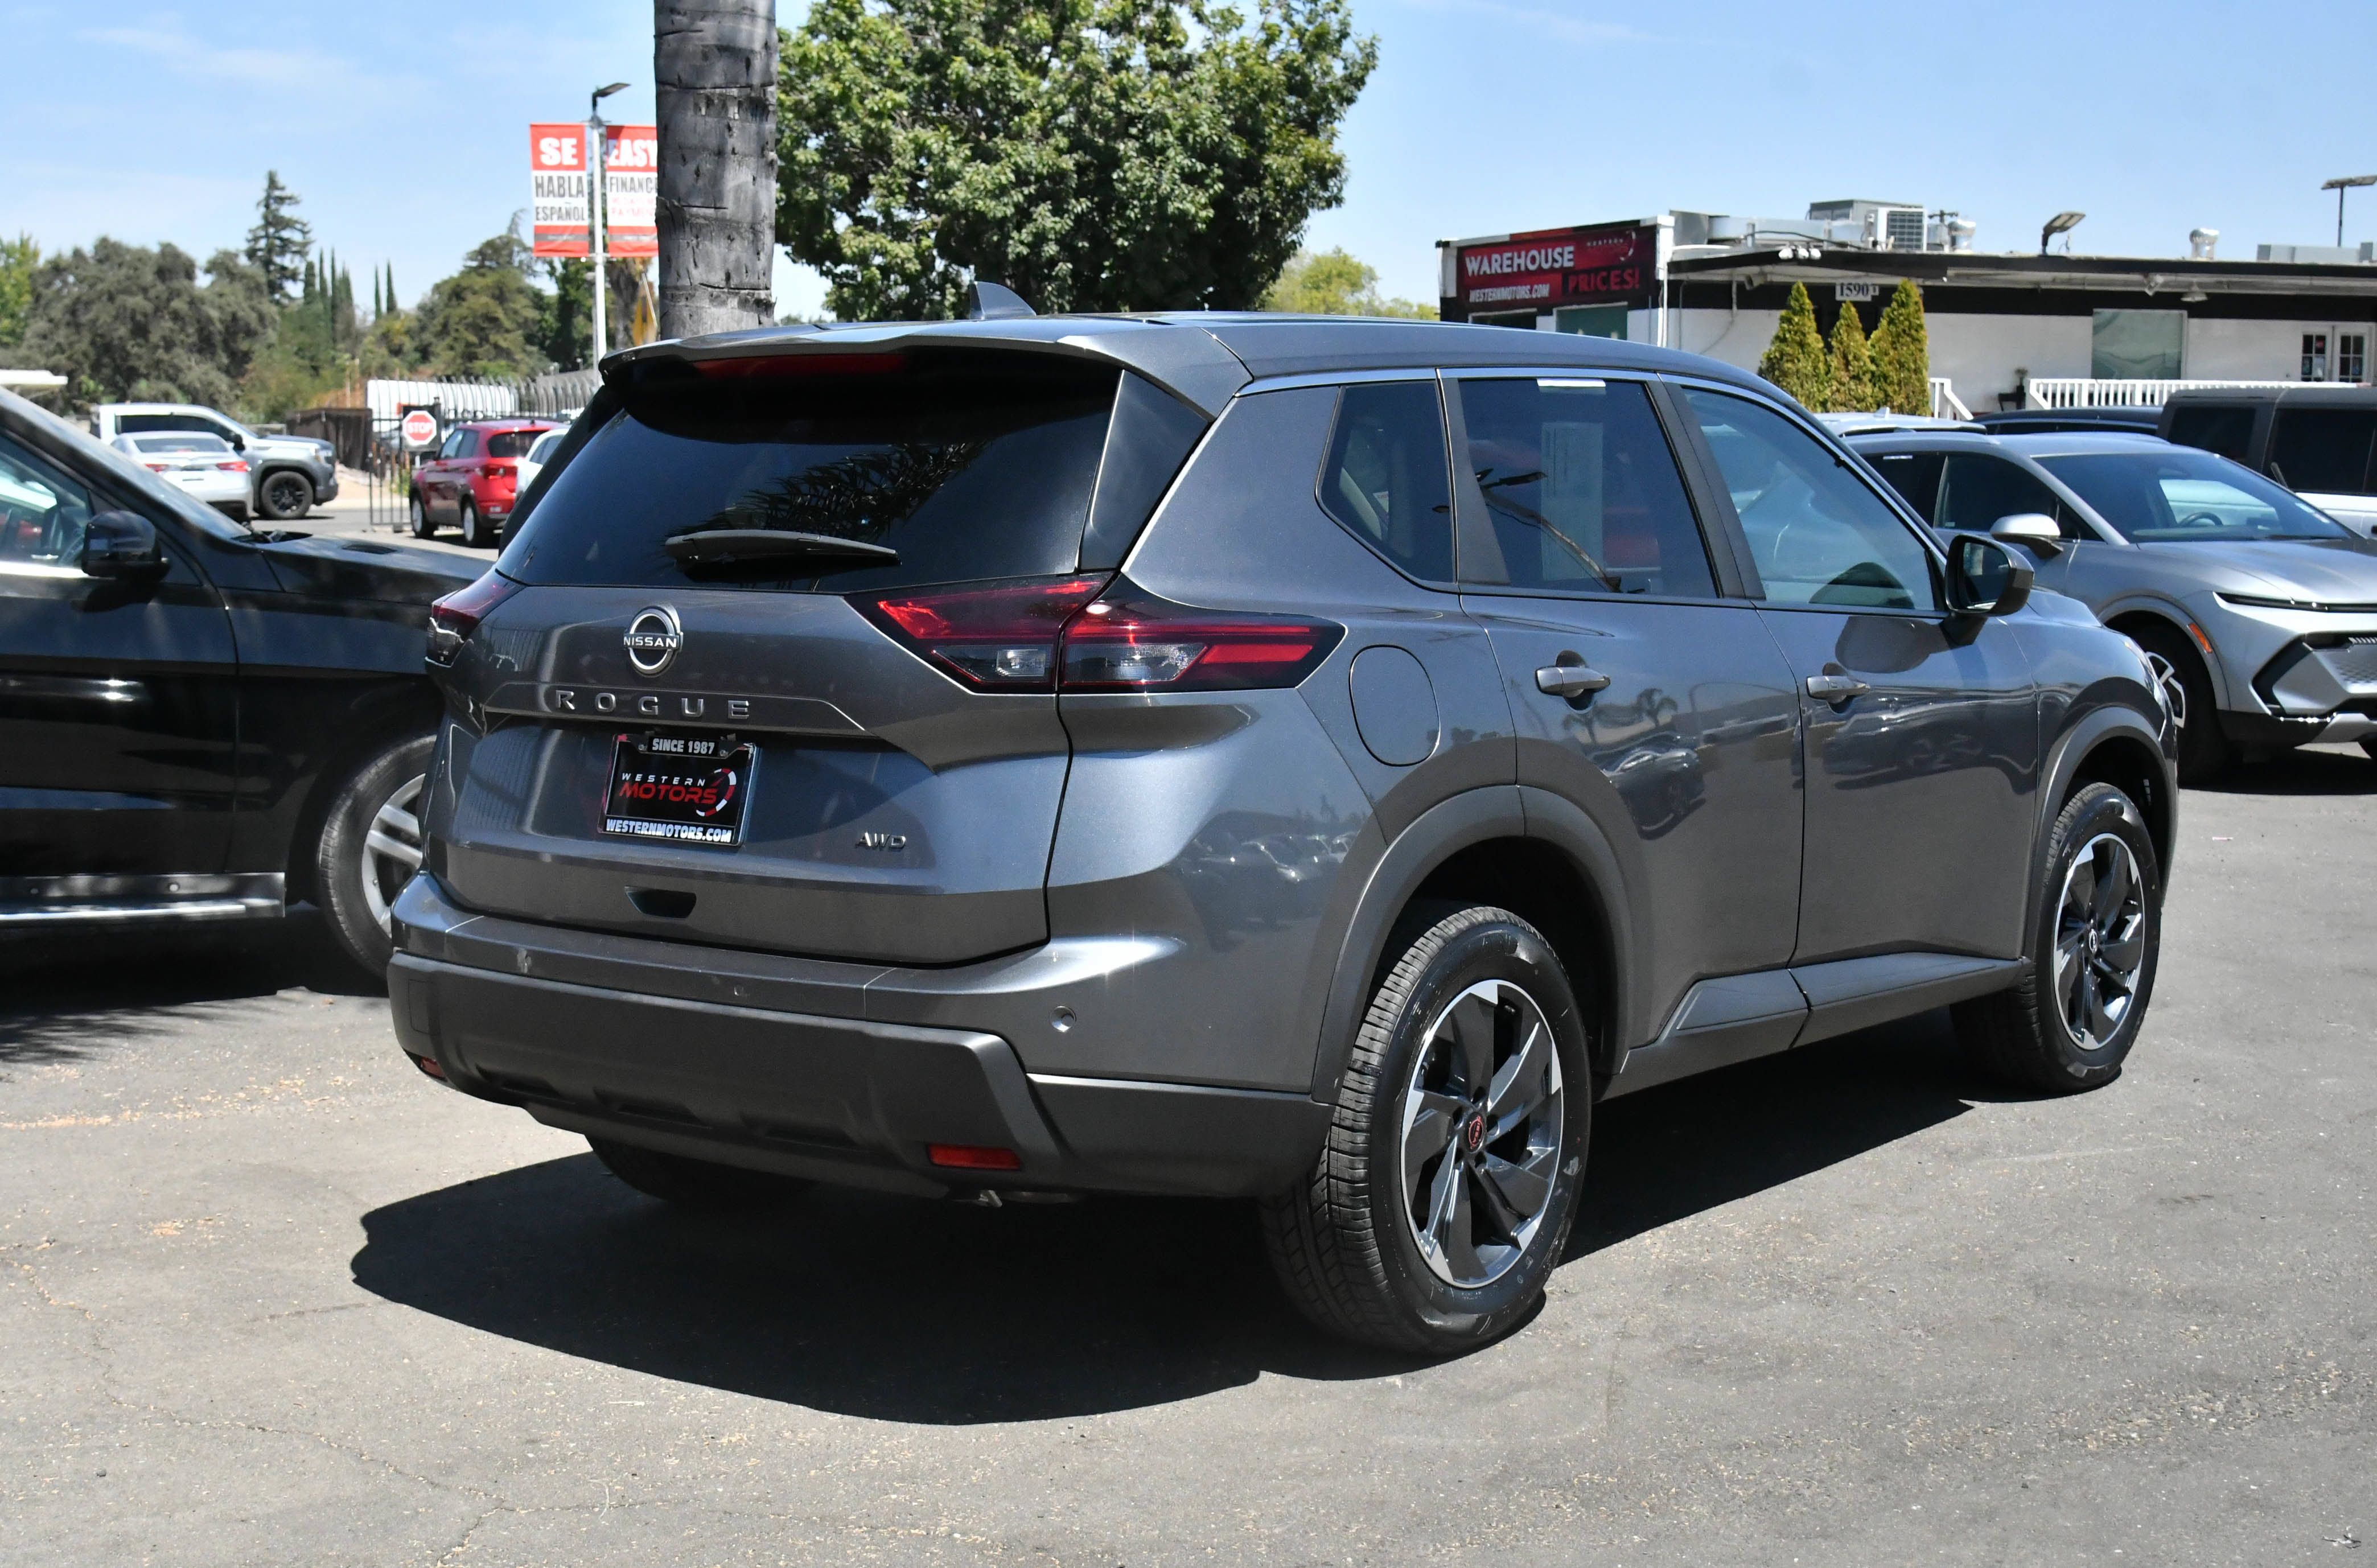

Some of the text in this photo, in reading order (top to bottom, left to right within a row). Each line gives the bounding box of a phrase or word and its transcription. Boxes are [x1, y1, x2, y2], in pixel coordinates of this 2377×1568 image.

[540, 137, 578, 166] SE
[534, 175, 585, 199] HABLA
[536, 201, 585, 221] ESPAÑOL
[1465, 245, 1574, 277] WAREHOUSE
[1569, 266, 1640, 293] PRICES!
[1839, 282, 1869, 297] 1590
[1469, 283, 1550, 303] WESTERNMOTORS.COM
[406, 422, 433, 433] STOP
[623, 636, 677, 648] NISSAN
[555, 689, 750, 719] ROGUE
[652, 738, 715, 755] SINCE 1987
[622, 772, 705, 787] WESTERN
[619, 782, 719, 804] MOTORS
[606, 818, 732, 843] WESTERNMOTORS.COM
[856, 832, 906, 849] AWD
